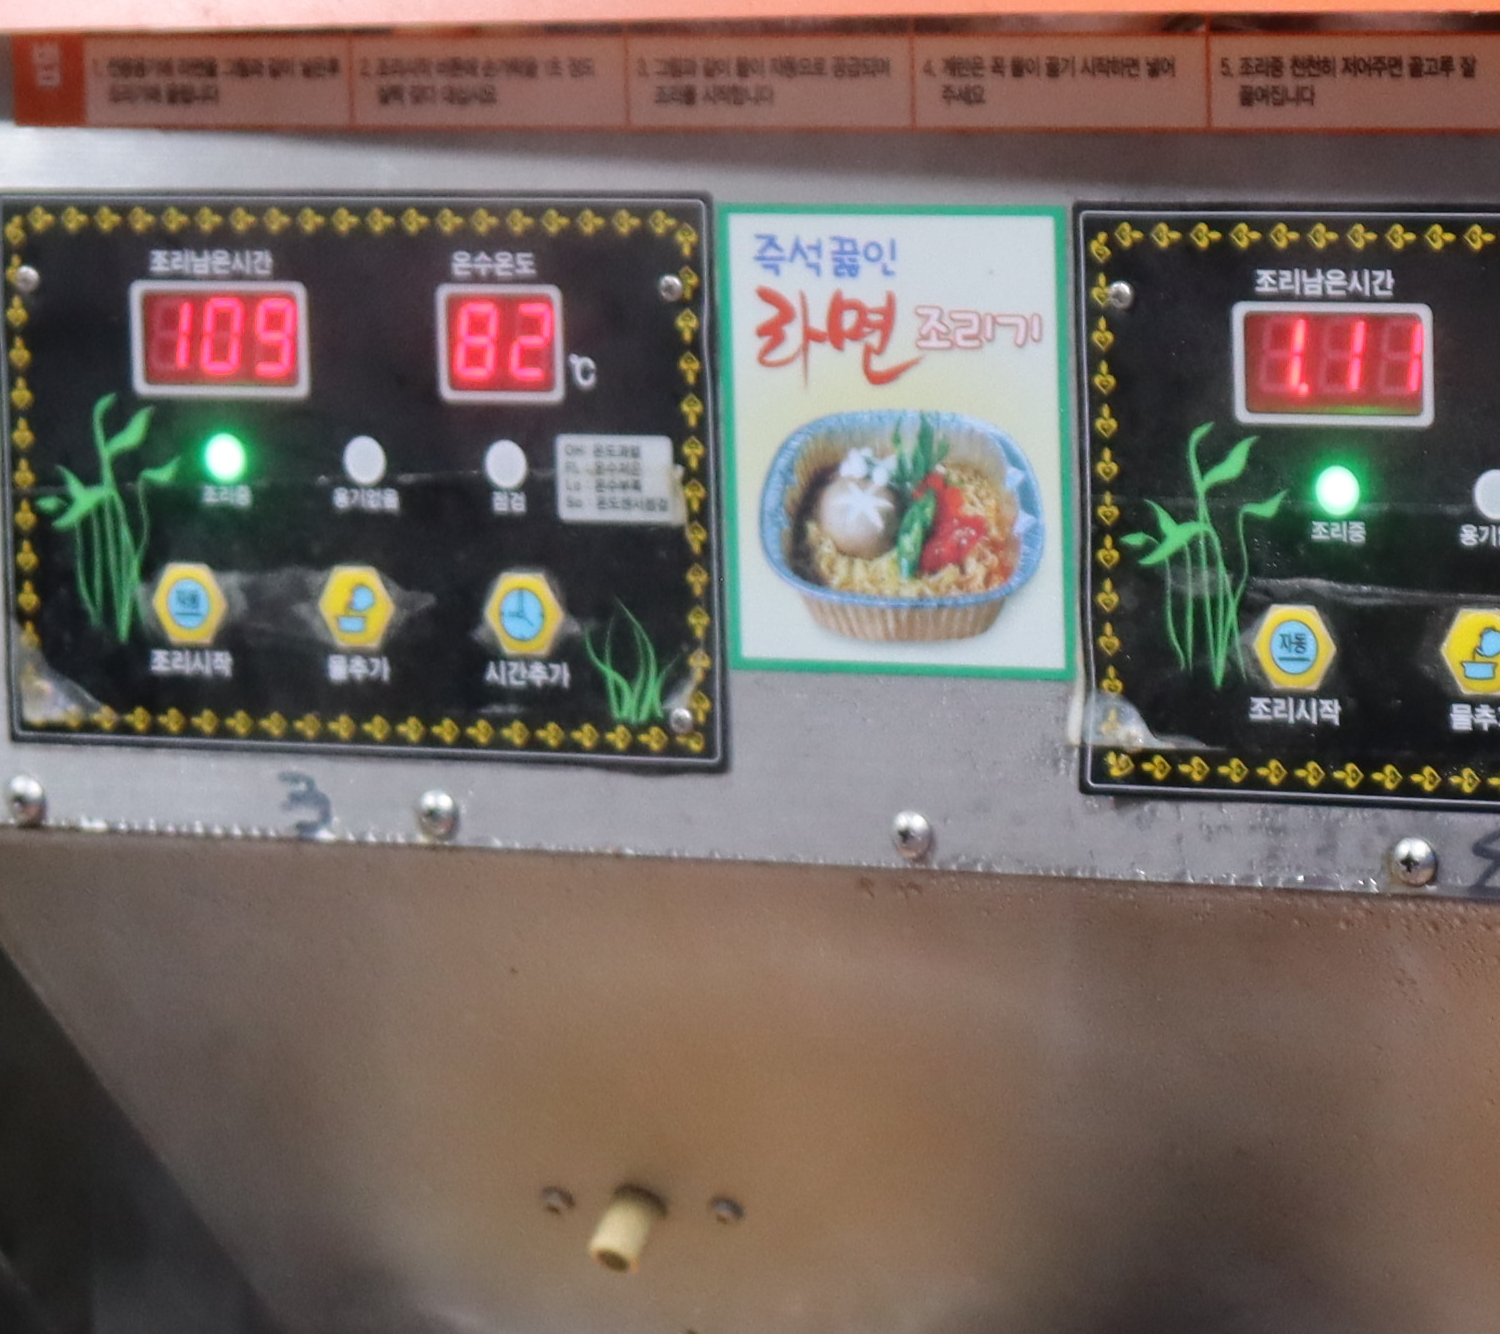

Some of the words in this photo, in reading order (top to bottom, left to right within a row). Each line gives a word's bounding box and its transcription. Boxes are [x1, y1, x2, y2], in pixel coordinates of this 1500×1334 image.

[149, 249, 274, 278] 조리남은시간
[451, 250, 537, 279] 온수온도
[752, 233, 824, 279] 즉석
[830, 235, 898, 279] 끓인
[1254, 268, 1395, 298] 조리남은시간
[175, 296, 300, 379] 109
[452, 298, 556, 383] 82
[755, 285, 924, 387] 라면
[915, 305, 1043, 351] 조리기
[1311, 516, 1367, 544] 조리중
[1280, 633, 1307, 654] 자동
[150, 649, 233, 677] 조리시작
[327, 648, 391, 683] 물추가
[485, 656, 571, 688] 시간추가
[1248, 696, 1342, 726] 조리시작
